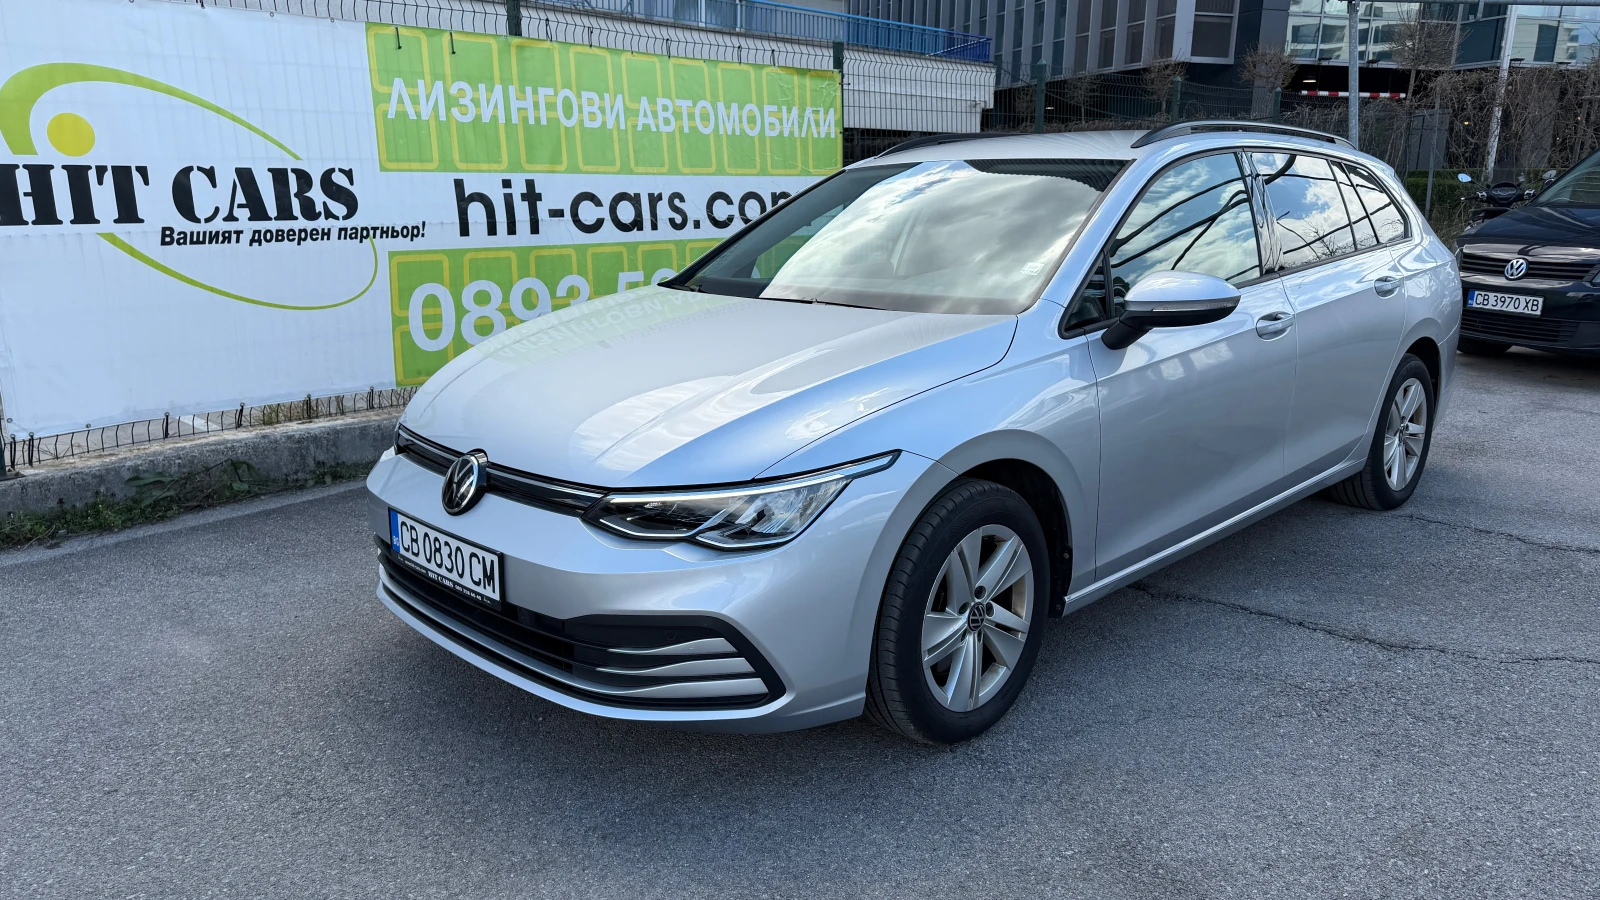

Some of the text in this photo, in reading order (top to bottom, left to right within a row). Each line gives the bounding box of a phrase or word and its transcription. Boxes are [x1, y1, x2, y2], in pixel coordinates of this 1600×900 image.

[388, 77, 836, 139] ЛИЗИНГОВИ АВТОМОБИЛИ
[0, 163, 359, 226] HIT CARS
[160, 221, 426, 246] Вашият доверен партньор!
[1475, 293, 1490, 307] CB
[1491, 295, 1521, 310] 3970
[1523, 298, 1540, 312] XB
[400, 520, 496, 594] CB 0830 CM
